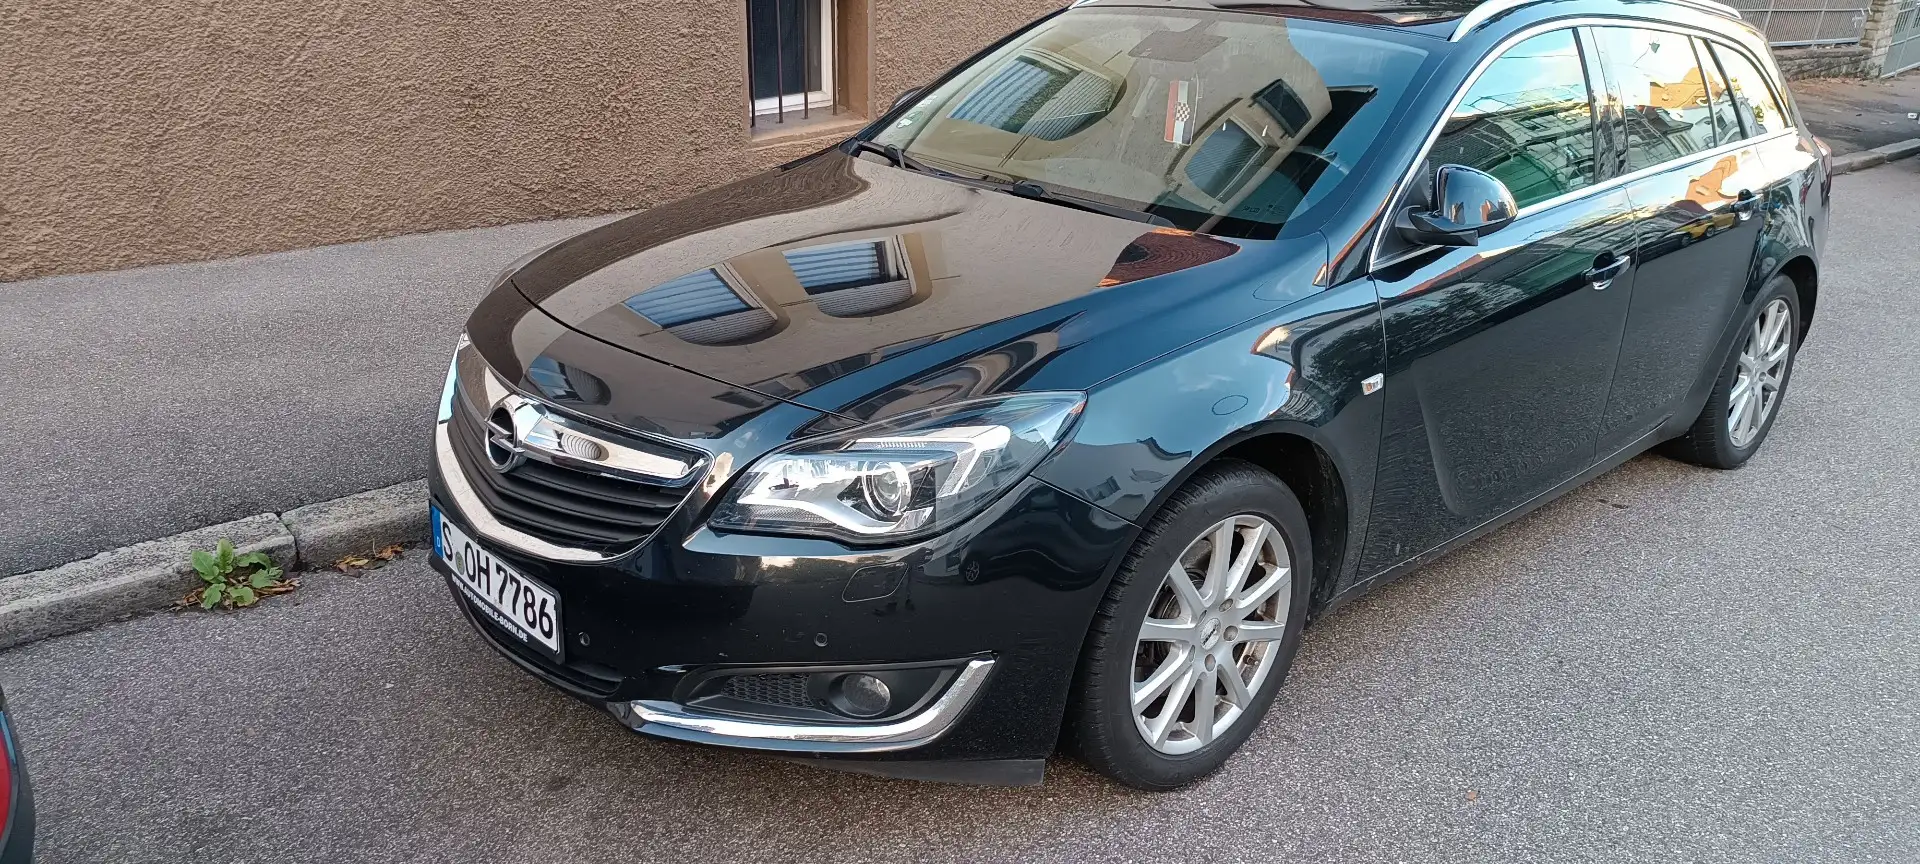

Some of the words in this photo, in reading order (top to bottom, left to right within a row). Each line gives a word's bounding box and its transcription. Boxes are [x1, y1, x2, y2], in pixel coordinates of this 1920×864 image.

[436, 536, 441, 548] D
[442, 521, 453, 562] S
[465, 541, 491, 597] OH
[496, 562, 554, 640] 7786
